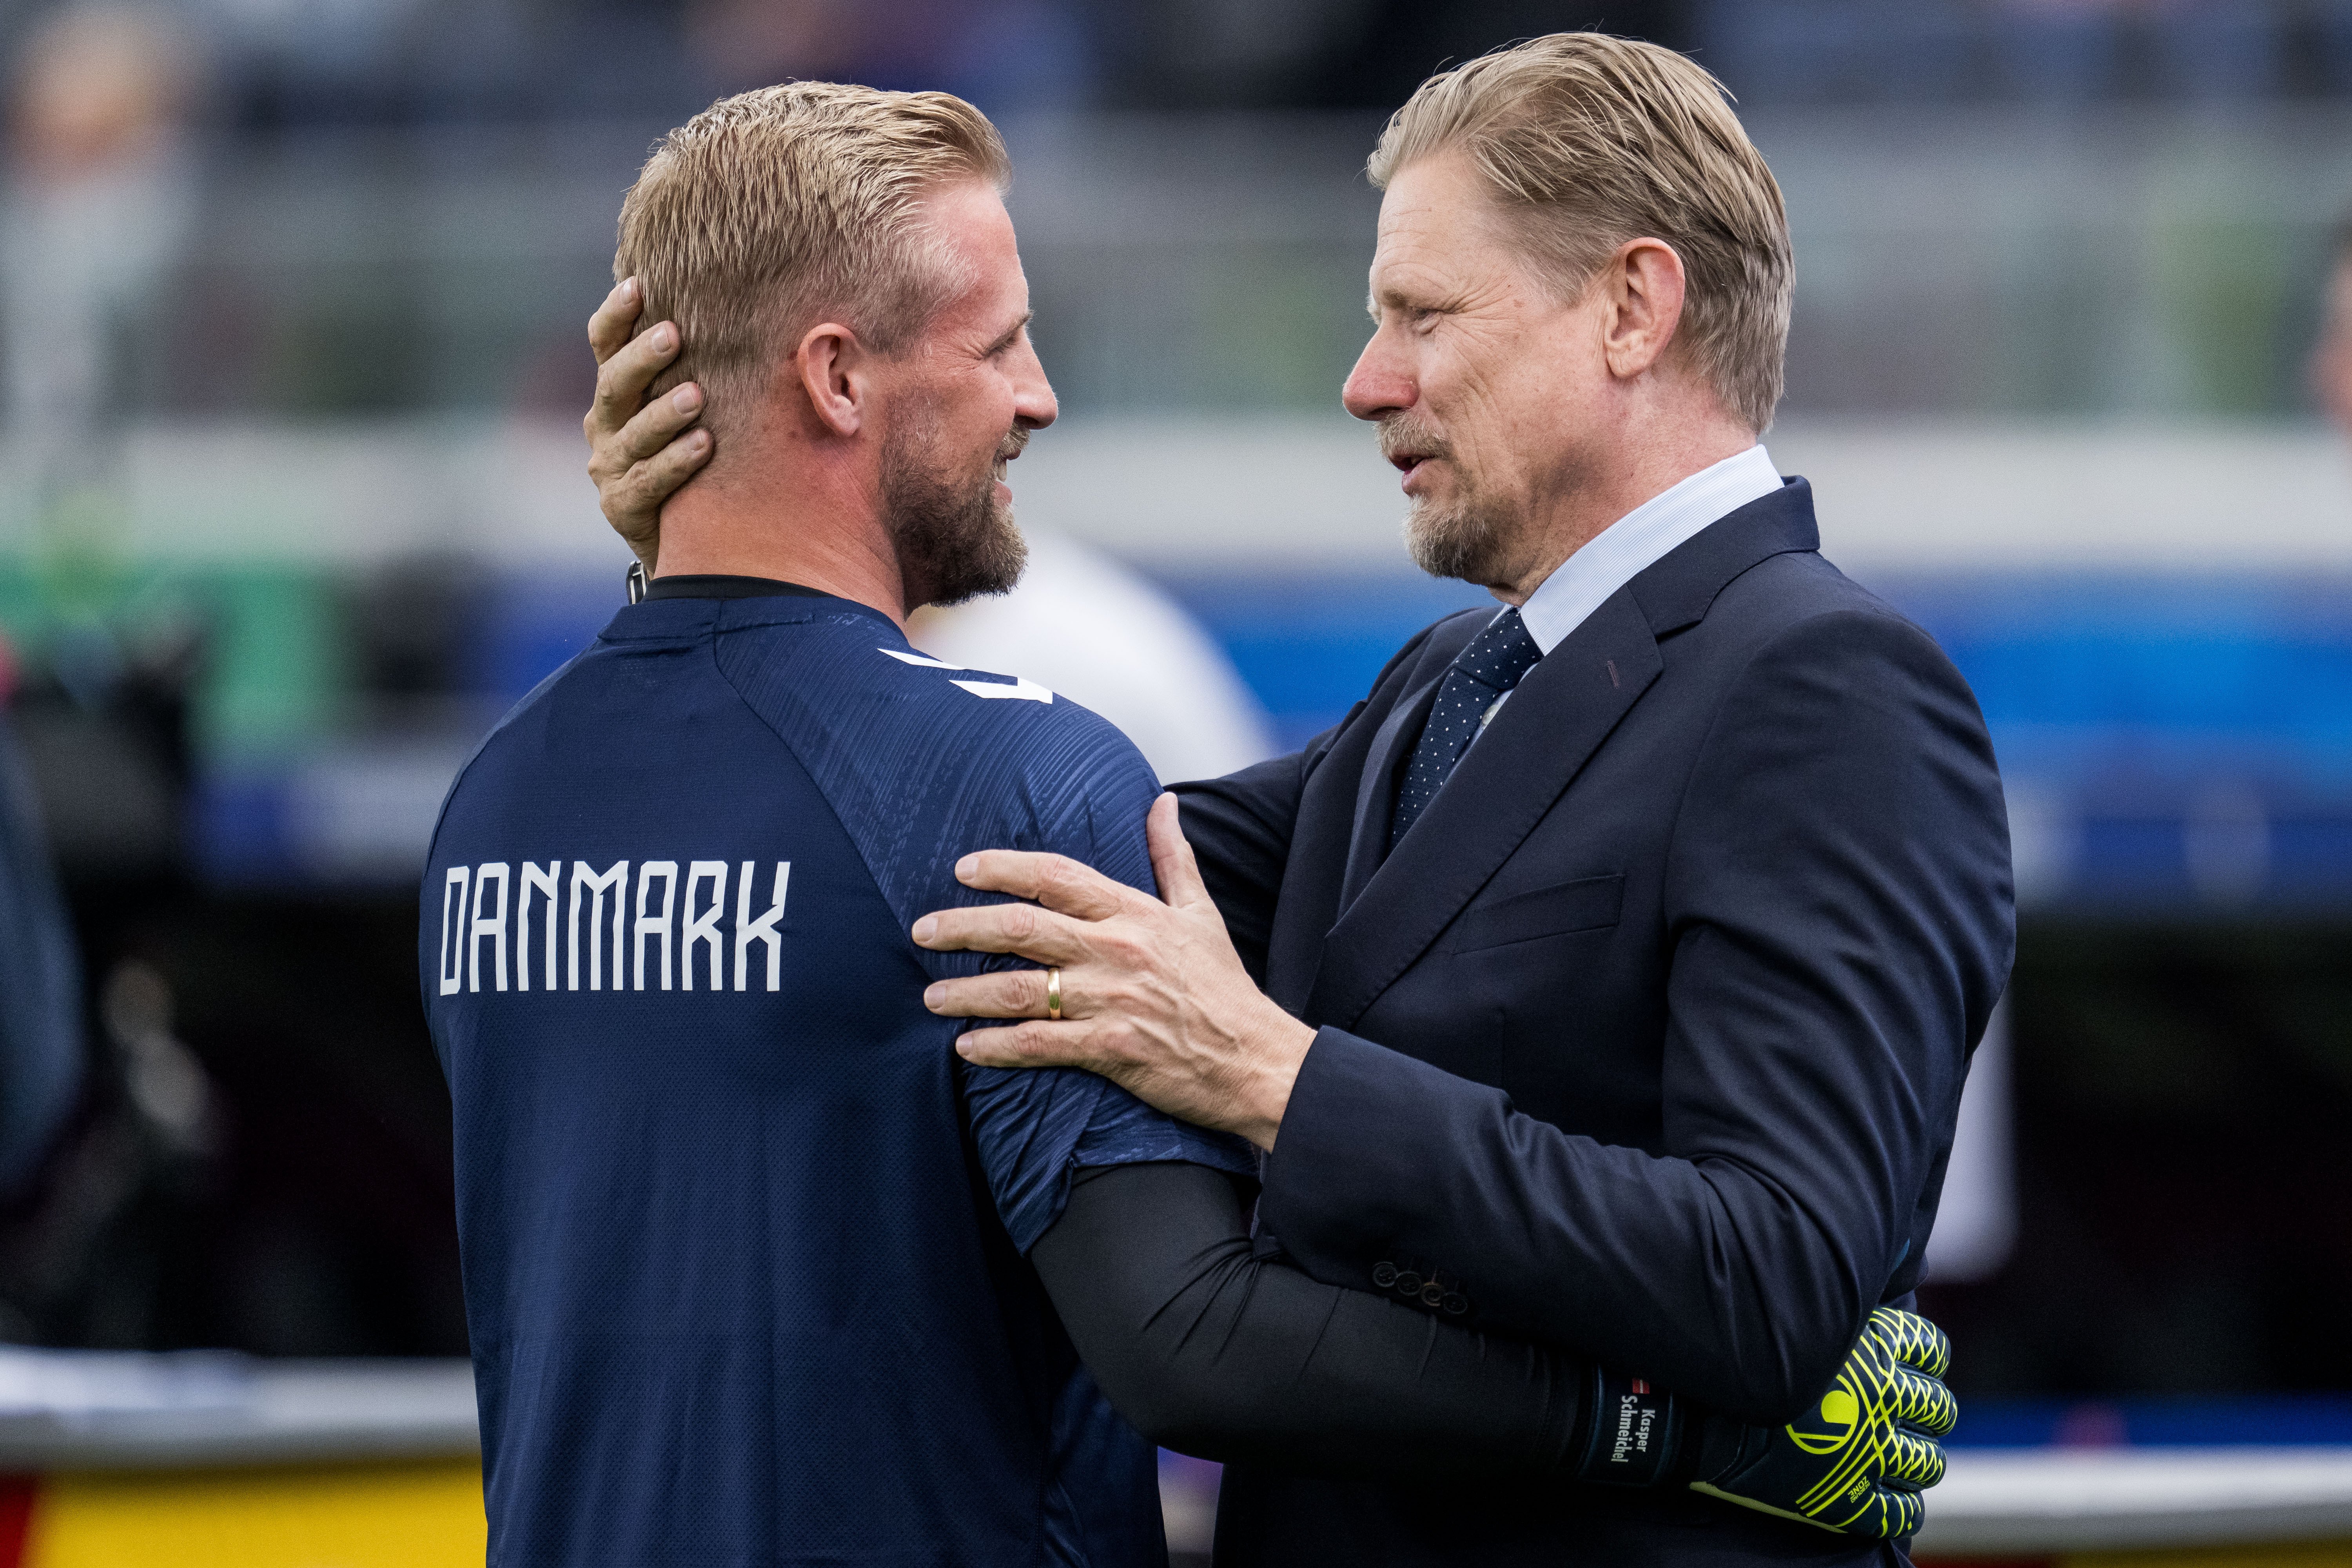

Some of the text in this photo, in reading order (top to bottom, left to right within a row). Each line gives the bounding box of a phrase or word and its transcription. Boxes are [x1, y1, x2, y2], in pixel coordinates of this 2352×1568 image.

[440, 860, 791, 996] DANMARK
[1611, 1396, 1638, 1463] Schmeichel
[1635, 1409, 1655, 1452] Kasper
[1847, 1475, 1869, 1499] ZONE
[1851, 1482, 1870, 1503] REBOUND
